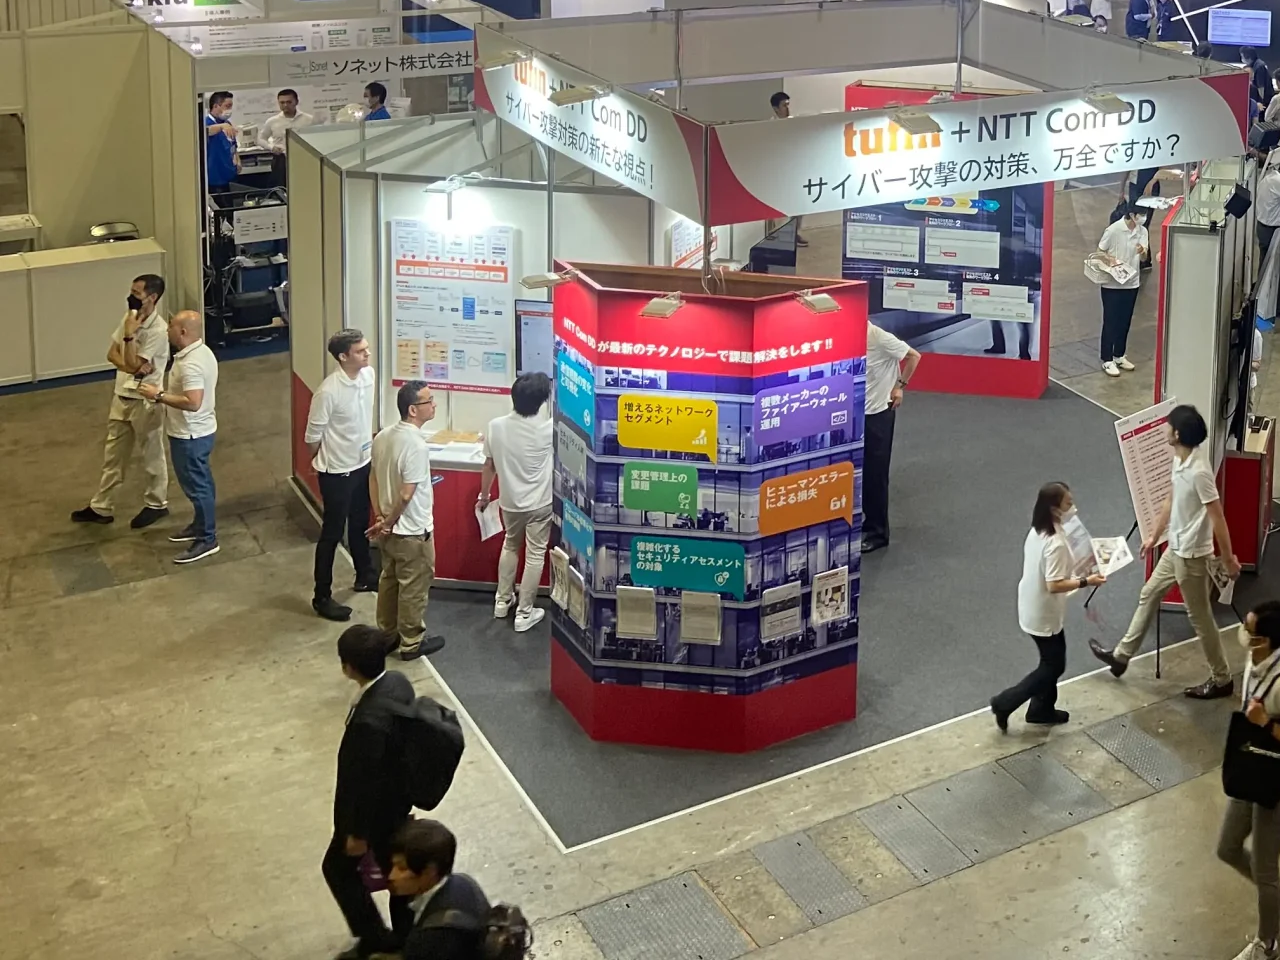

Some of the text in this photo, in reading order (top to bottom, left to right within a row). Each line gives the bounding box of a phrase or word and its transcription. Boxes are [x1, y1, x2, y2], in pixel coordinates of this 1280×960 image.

[333, 51, 473, 76] ソネット株式会社
[590, 99, 623, 133] Com
[626, 109, 649, 144] DD
[977, 110, 1038, 142] NTT
[1045, 106, 1108, 135] Com
[1118, 98, 1157, 125] DD
[802, 132, 1182, 204] サイバー攻撃の対策、万全ですか？
[878, 214, 883, 222] 1
[914, 269, 919, 277] 3
[564, 317, 576, 334] NTT
[576, 326, 587, 344] Com
[587, 335, 596, 350] DD
[760, 384, 829, 410] 複数メーカーの
[760, 390, 848, 419] ファイアーウォール
[624, 401, 714, 419] 増えるネットワーク
[624, 414, 673, 427] セグメント
[760, 416, 781, 430] 運用
[631, 470, 688, 484] 変更管理上の
[631, 480, 650, 492] 課題
[766, 470, 850, 499] ヒューマンエラー
[766, 488, 818, 510] による損失
[636, 542, 680, 554] 複雑化する
[636, 552, 742, 568] セキュリティアセスメント
[636, 560, 663, 573] の対象
